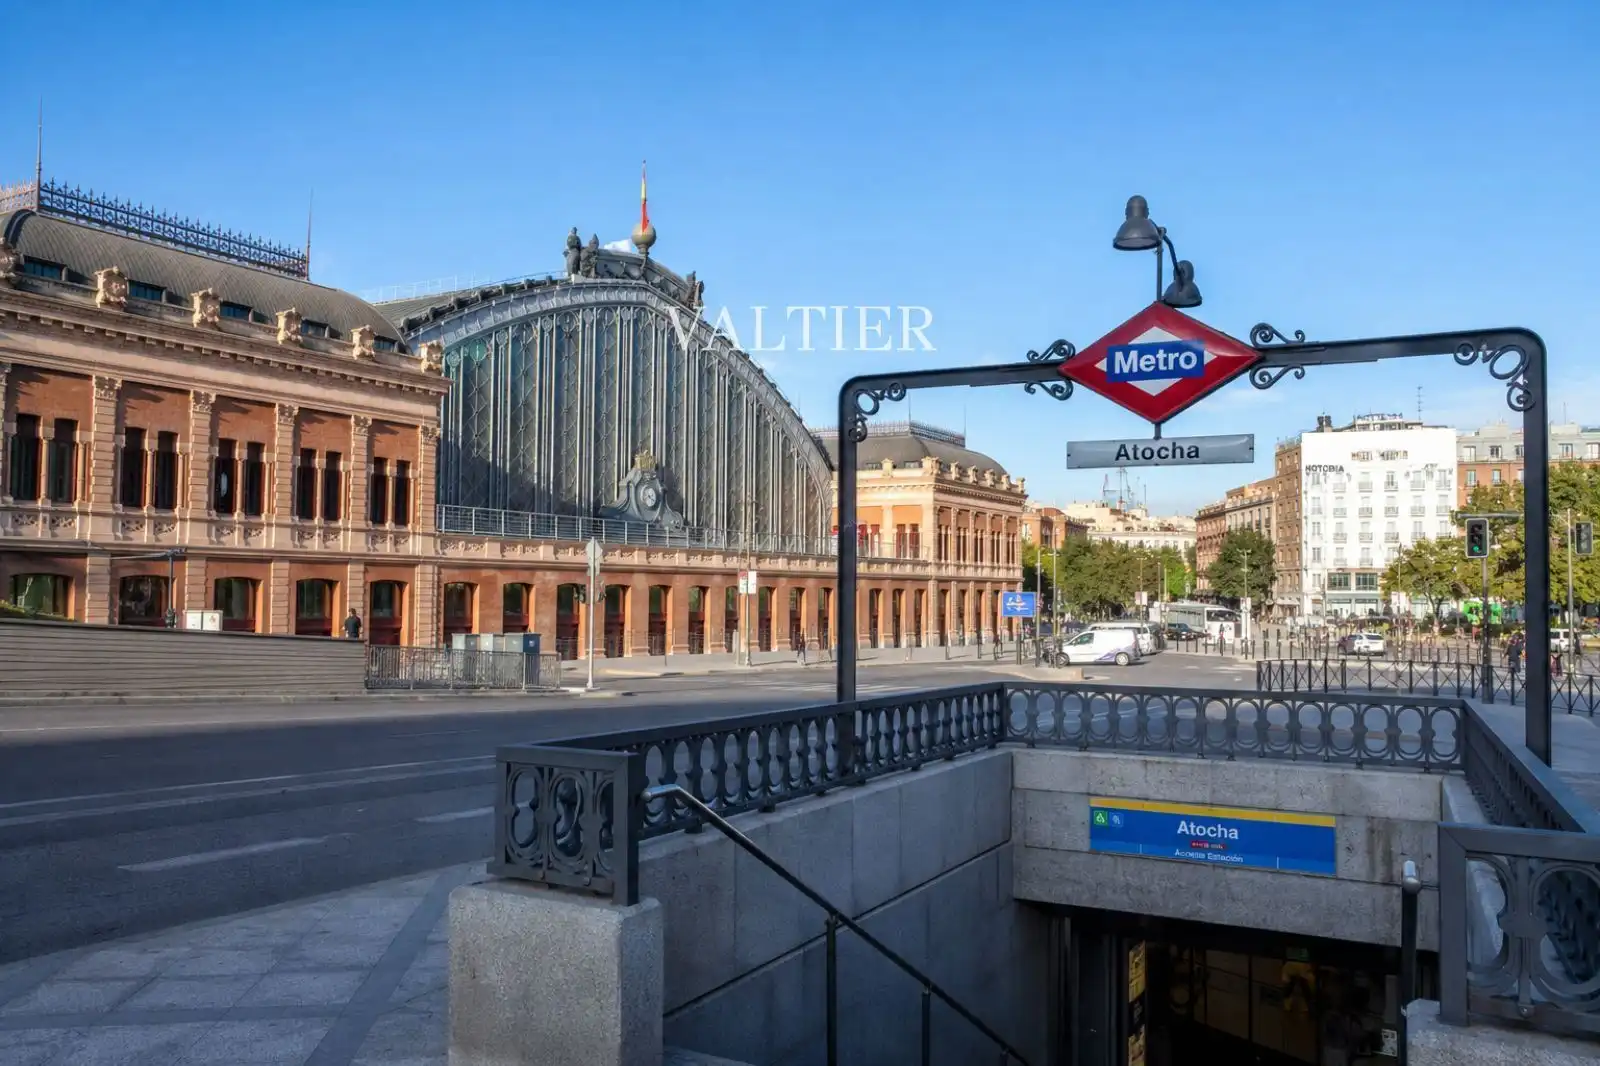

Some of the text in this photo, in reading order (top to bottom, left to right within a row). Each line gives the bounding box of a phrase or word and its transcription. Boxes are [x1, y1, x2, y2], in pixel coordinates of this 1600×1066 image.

[1114, 349, 1198, 374] Metro
[1114, 442, 1200, 461] Atocha
[1177, 820, 1239, 840] Atocha
